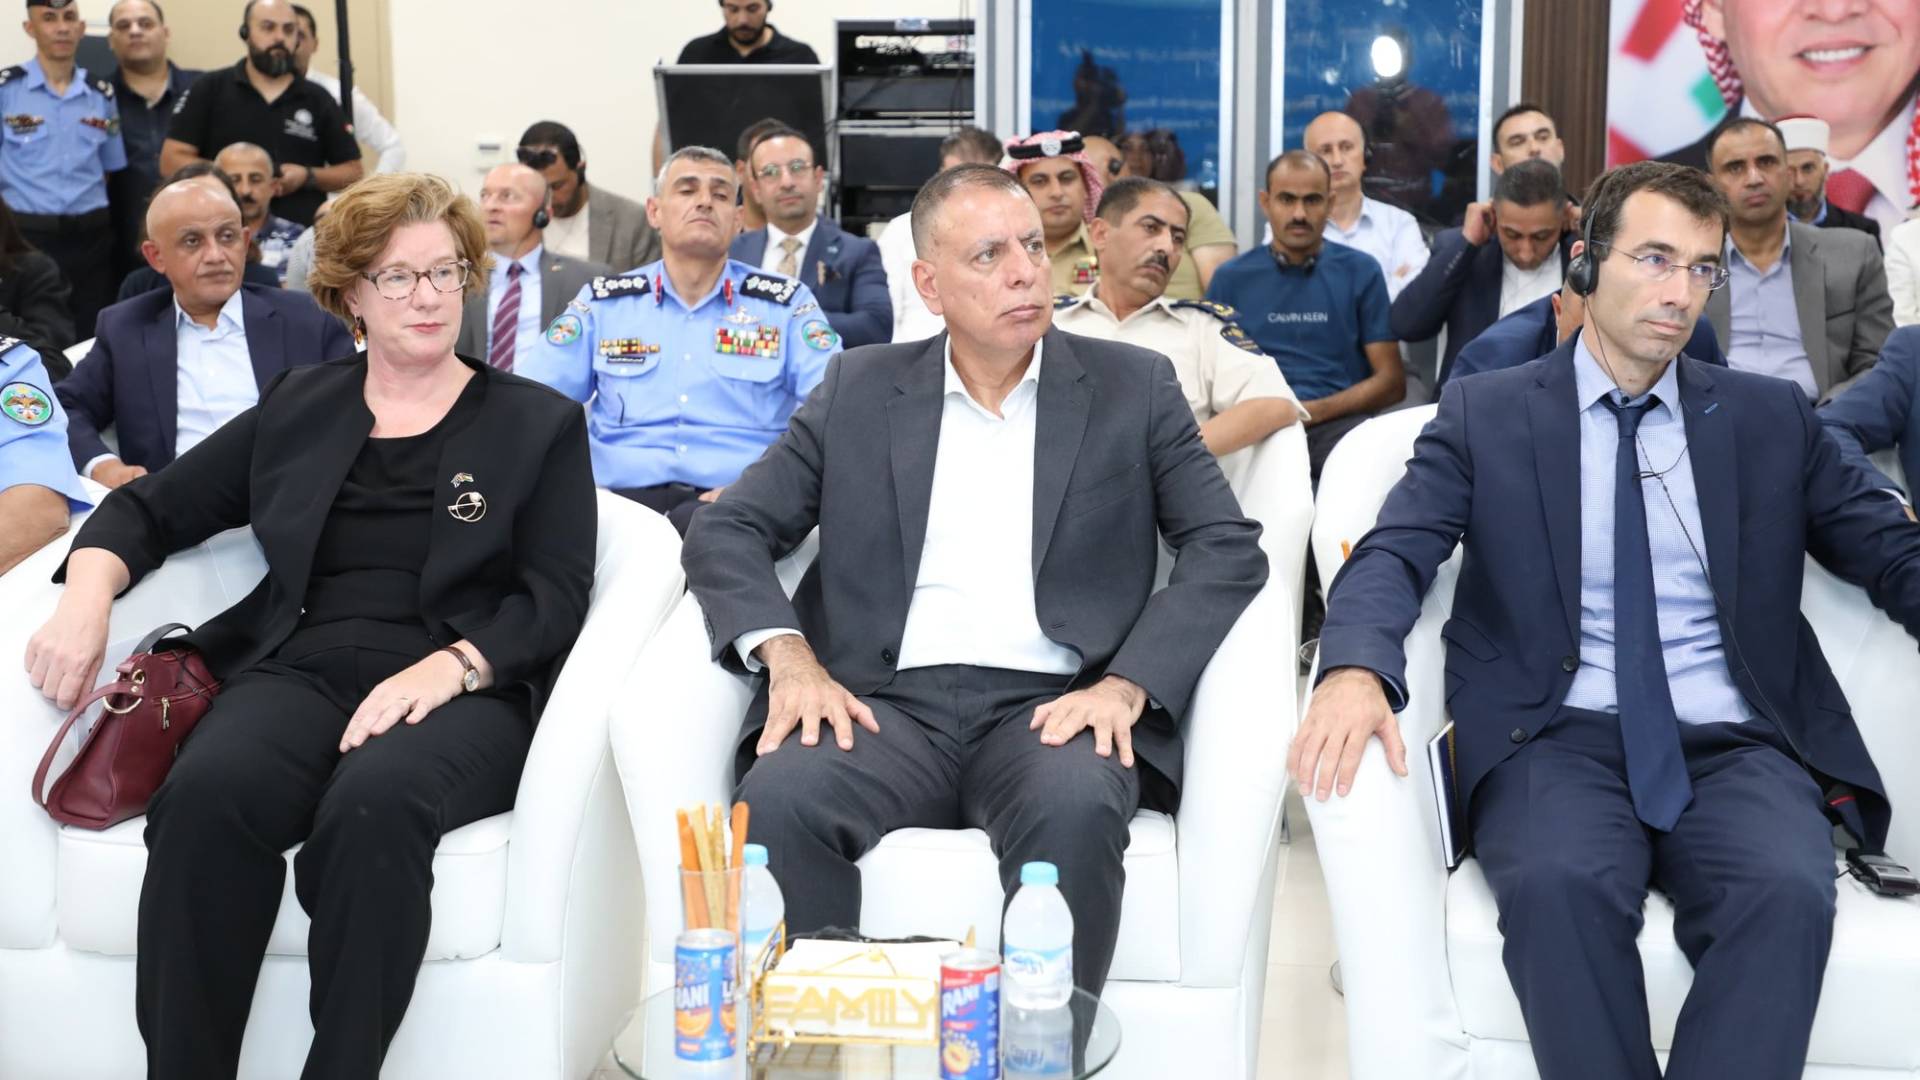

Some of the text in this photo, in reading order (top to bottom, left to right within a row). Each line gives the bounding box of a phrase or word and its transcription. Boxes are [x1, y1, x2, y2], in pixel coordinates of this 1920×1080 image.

[1268, 311, 1328, 323] CALVIN KLEIN
[765, 985, 937, 1028] FAMILY
[943, 984, 980, 1018] RANI
